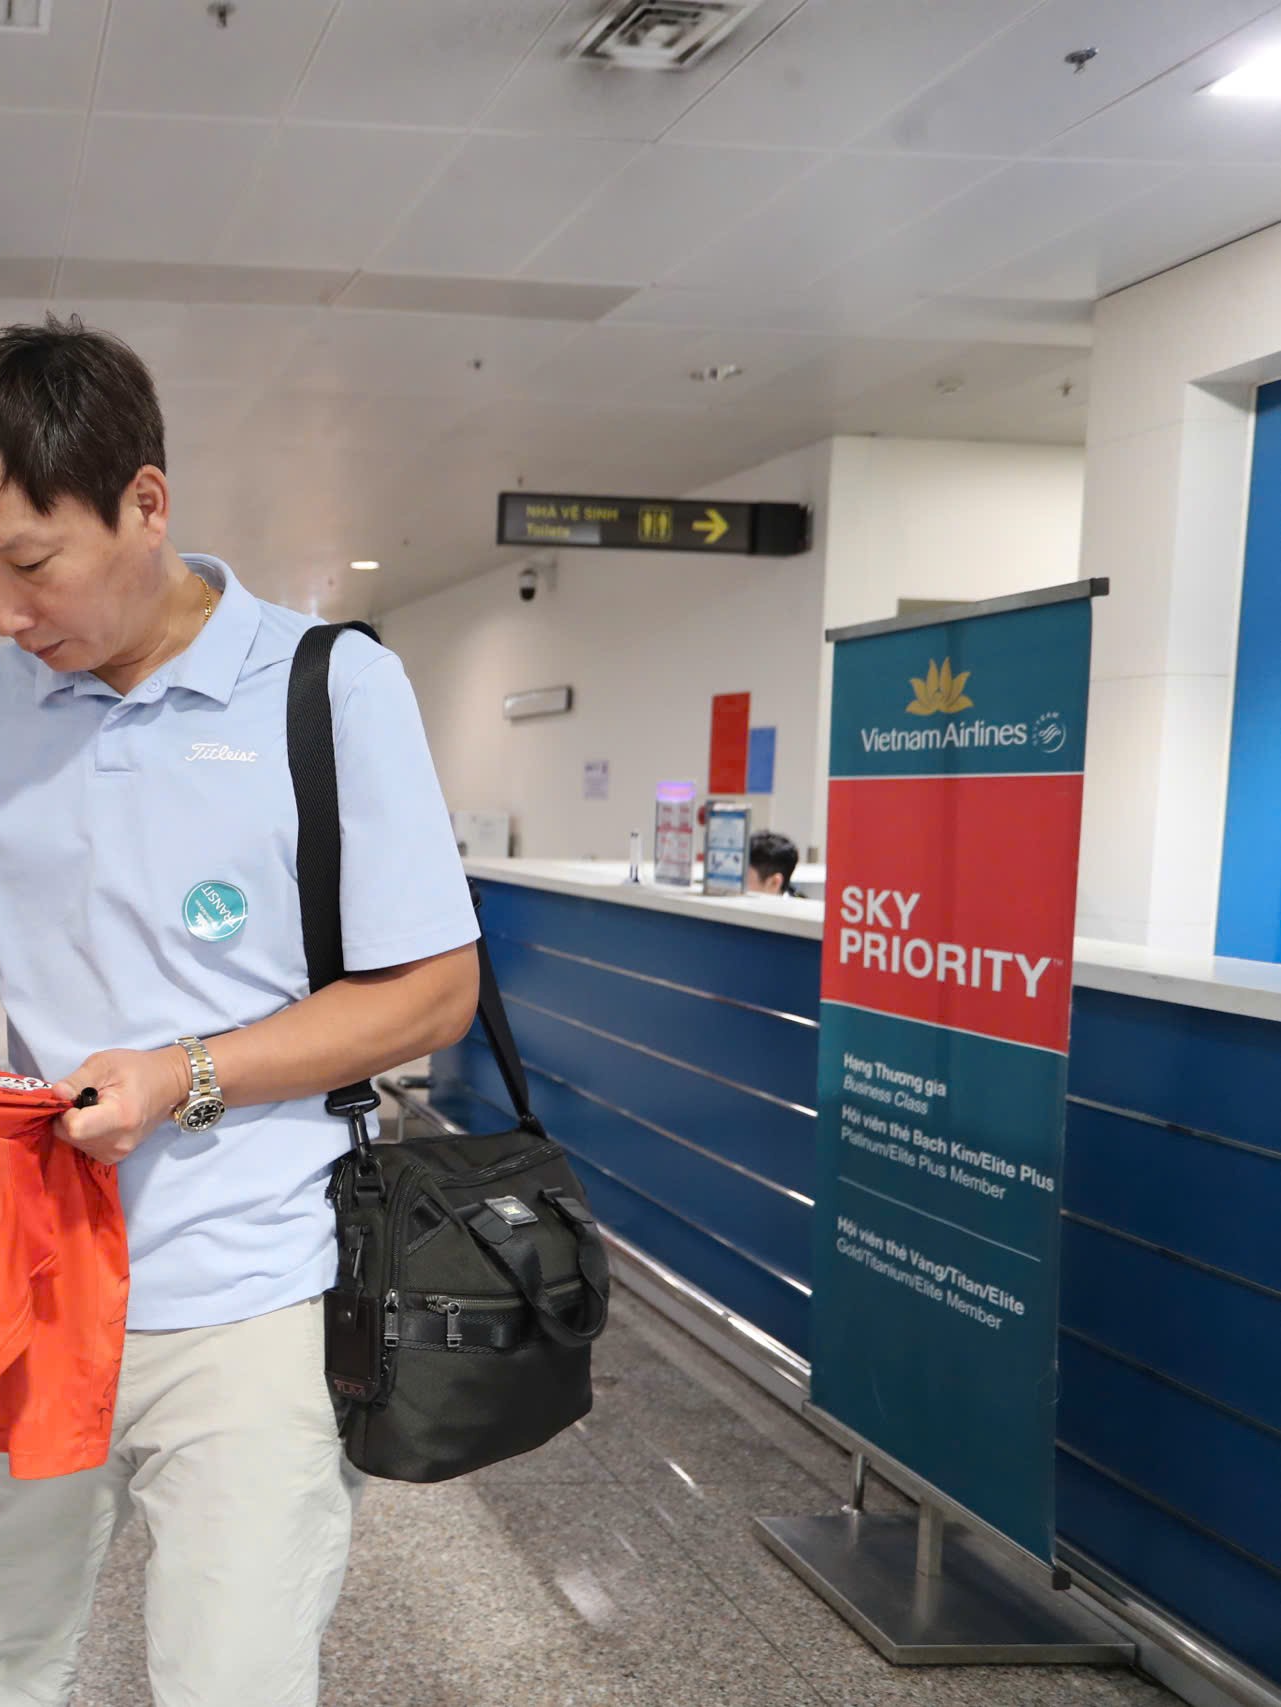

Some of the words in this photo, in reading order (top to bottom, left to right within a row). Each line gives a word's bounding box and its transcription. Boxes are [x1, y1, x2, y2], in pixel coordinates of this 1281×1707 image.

[583, 506, 618, 520] SINH
[184, 742, 258, 762] Titleist
[840, 886, 920, 930] SKY
[839, 928, 1051, 998] PRIORITY
[843, 1074, 891, 1104] Business
[894, 1091, 928, 1115] Class
[924, 1079, 947, 1097] gia
[841, 1126, 915, 1167] Platinum/Elite
[919, 1155, 947, 1178] Plus
[950, 1165, 1006, 1200] Member
[913, 1129, 947, 1155] Bạch
[950, 1141, 1016, 1178] Kim/Elite
[1020, 1164, 1055, 1192] Plus
[836, 1237, 943, 1301] Gold/Titanium/Elite
[946, 1290, 1003, 1330] Member
